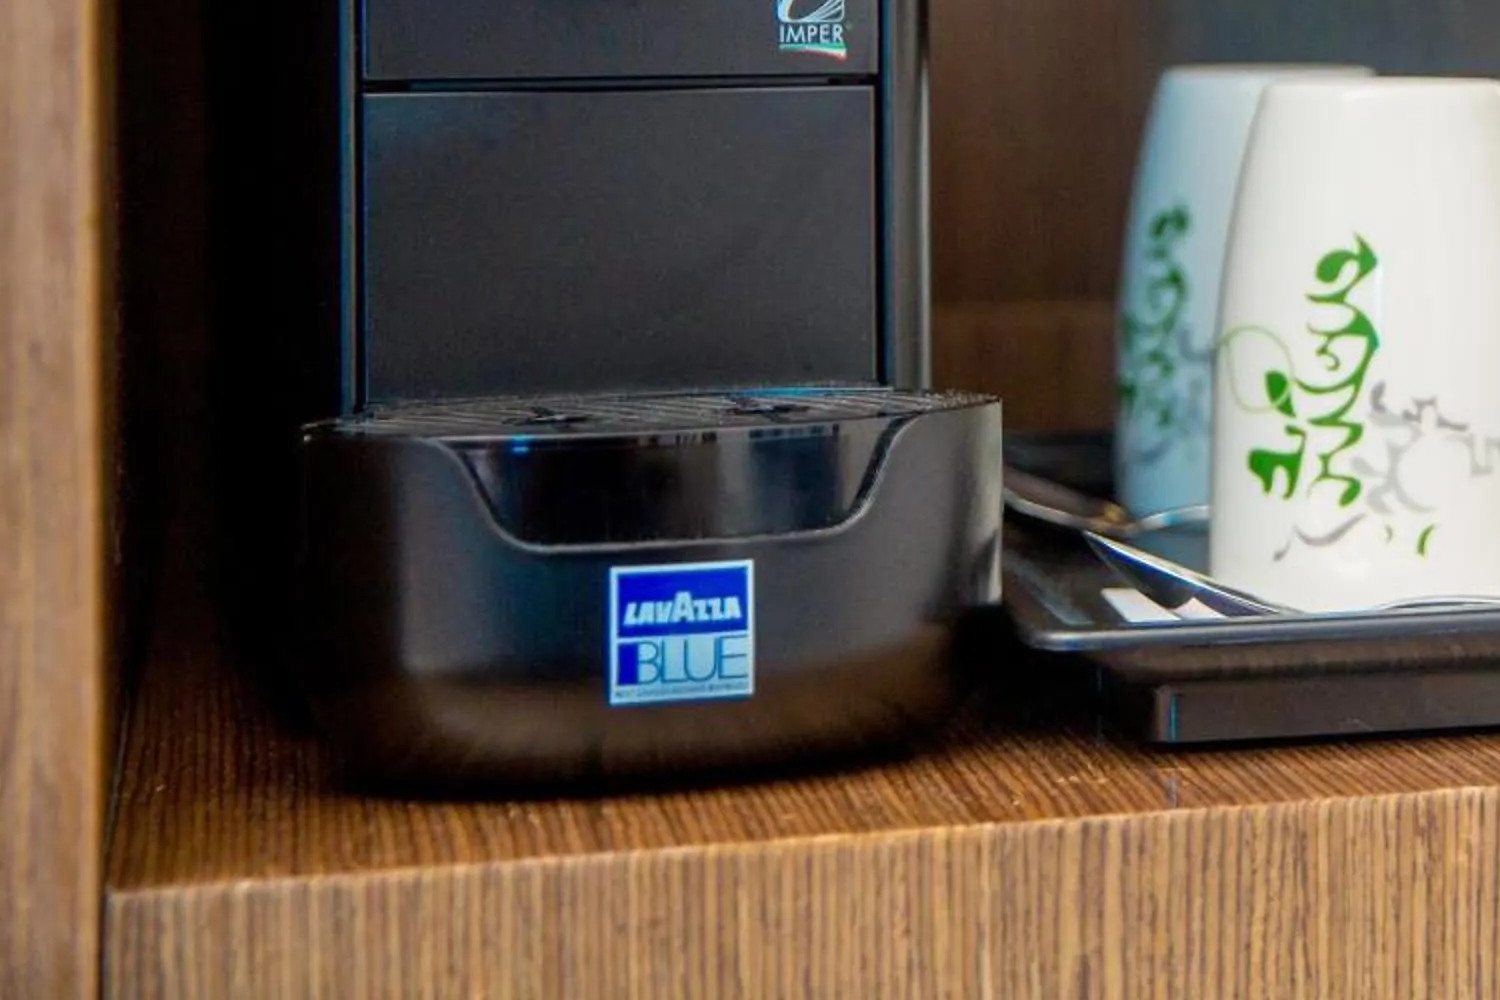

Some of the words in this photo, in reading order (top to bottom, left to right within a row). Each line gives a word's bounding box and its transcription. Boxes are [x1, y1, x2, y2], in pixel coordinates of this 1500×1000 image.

[779, 23, 844, 43] IMPER
[622, 591, 743, 626] LAVAZZA
[617, 634, 749, 685] BLUE
